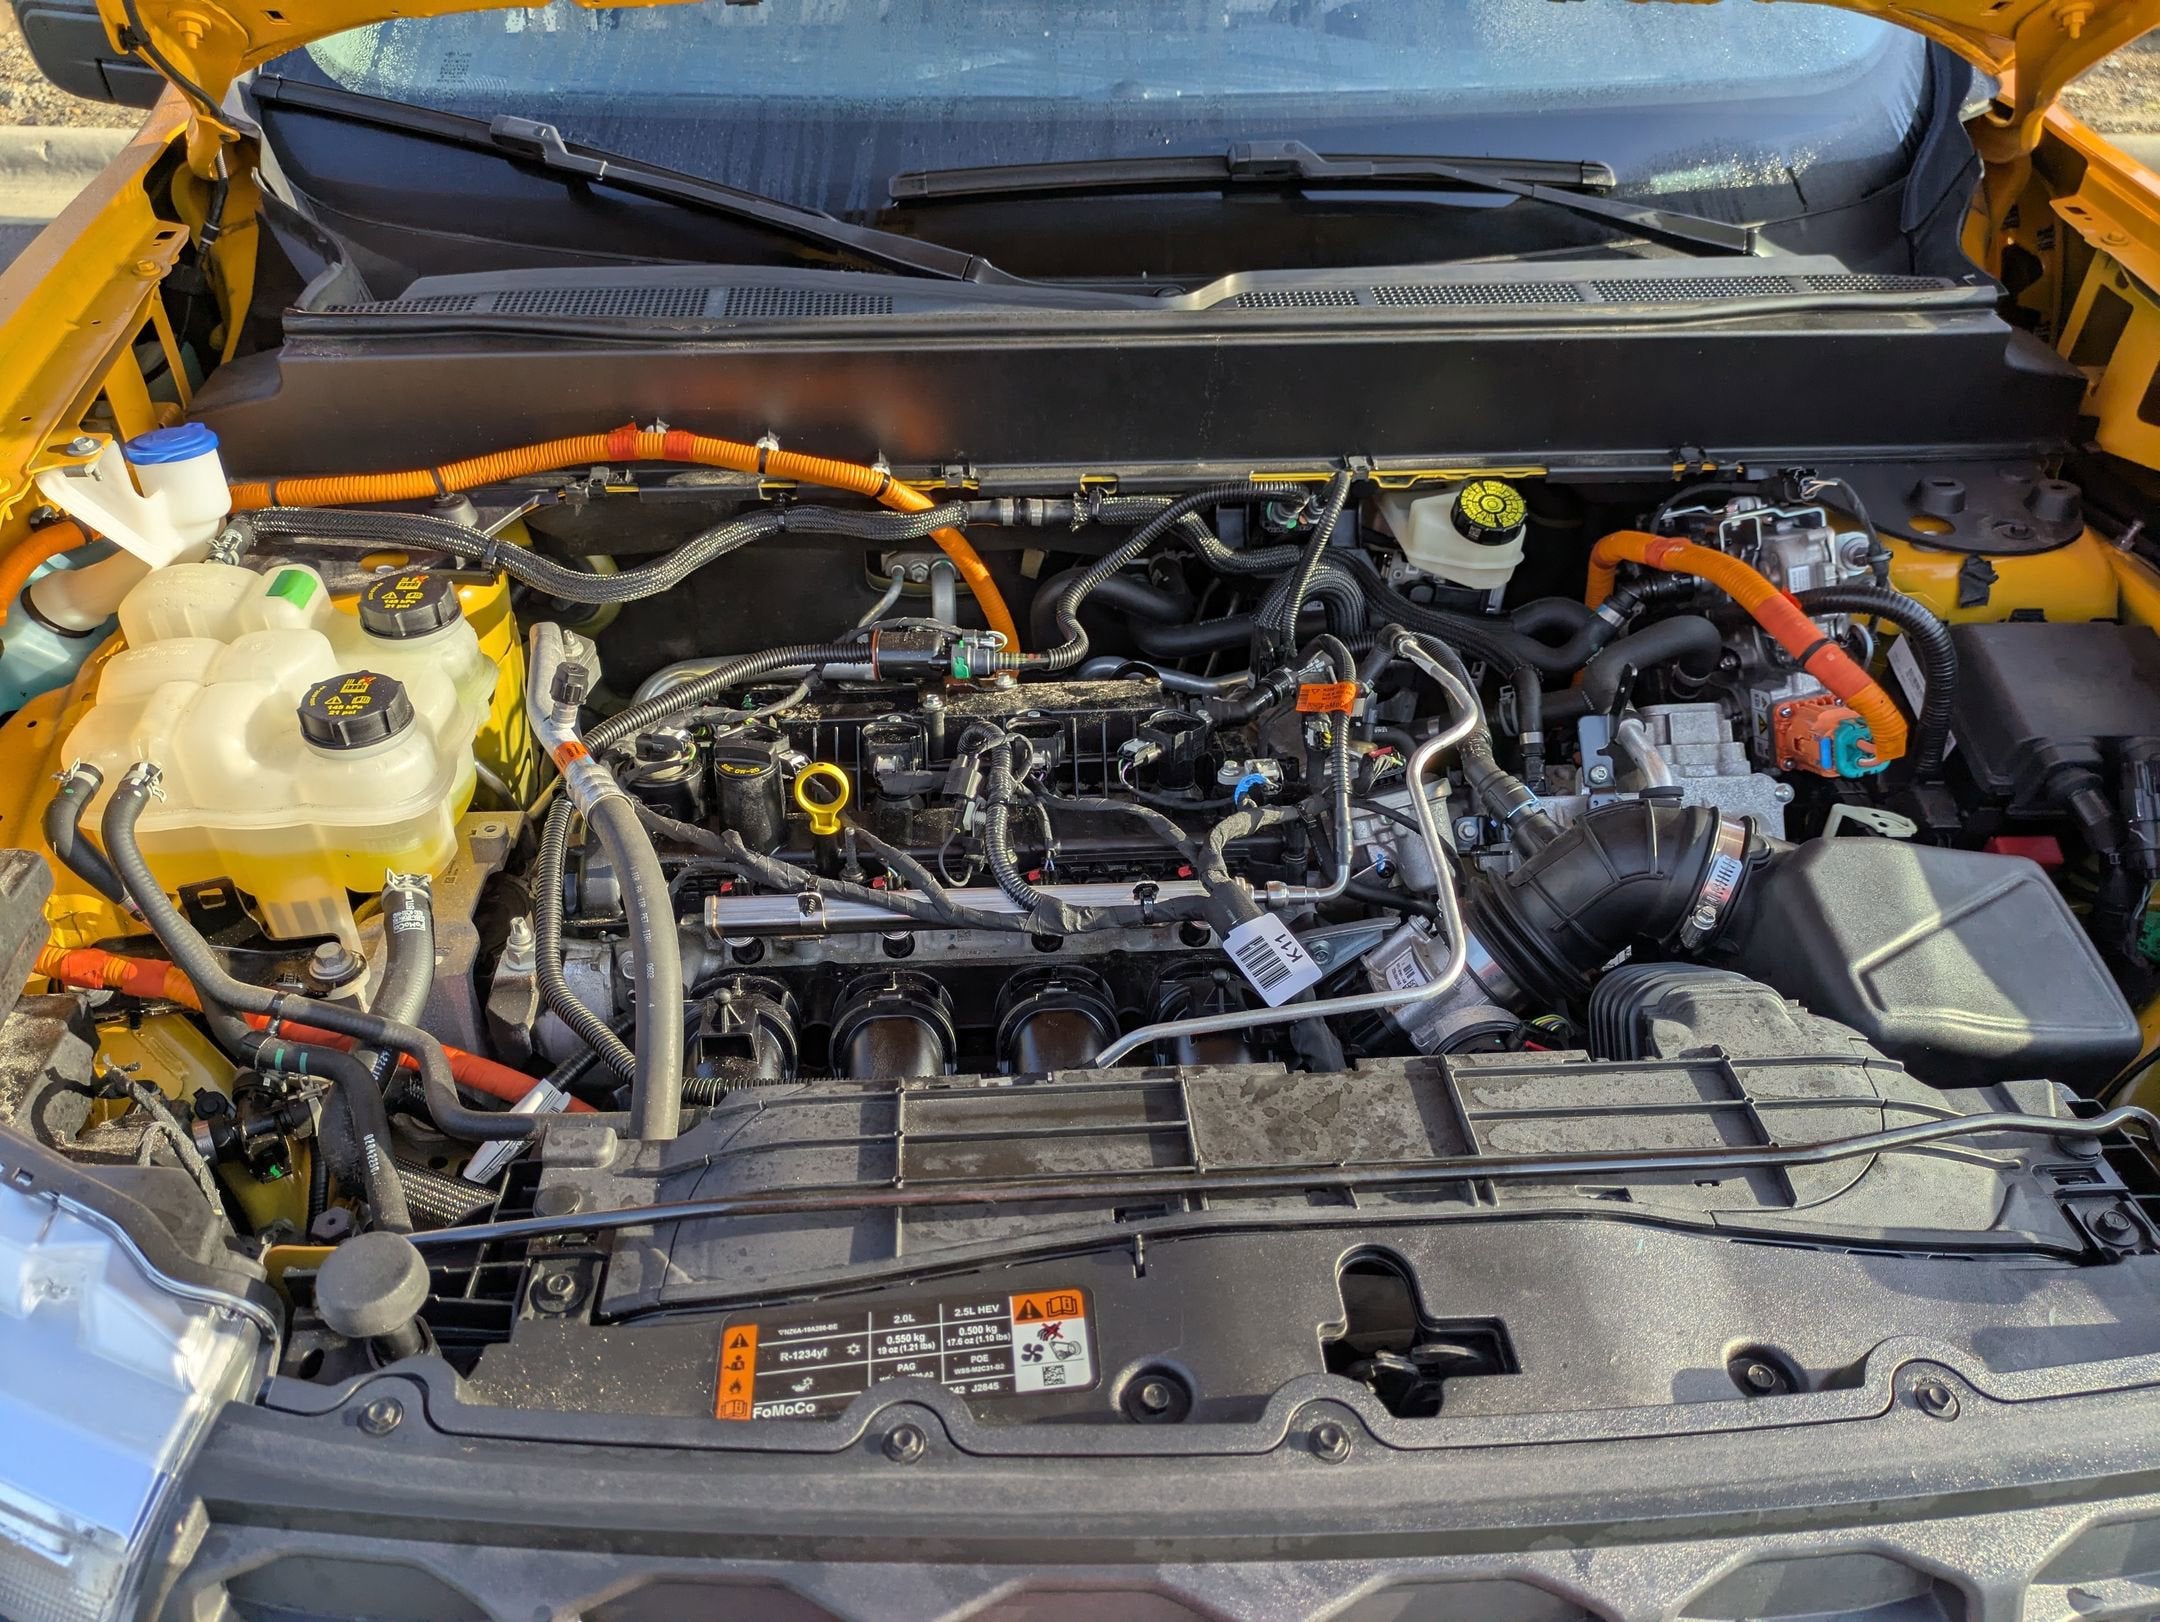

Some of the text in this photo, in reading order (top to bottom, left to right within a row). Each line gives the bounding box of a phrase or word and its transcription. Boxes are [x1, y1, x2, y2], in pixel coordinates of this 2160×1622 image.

[1274, 933, 1303, 963] K11
[954, 1304, 1000, 1317] 2.5L HEV
[893, 1314, 916, 1324] 2.0L
[958, 1324, 998, 1336] 0.500 kg
[886, 1333, 926, 1345] 0.550 kg
[946, 1338, 964, 1347] 17.6
[975, 1334, 995, 1345] (1.10
[995, 1332, 1011, 1342] lbs)
[877, 1346, 887, 1355] 19
[899, 1343, 919, 1354] (1.21
[919, 1341, 936, 1351] lbs)
[780, 1347, 829, 1362] R-1234yf
[970, 1354, 989, 1363] POE
[897, 1362, 916, 1372] PAG
[971, 1382, 1000, 1393] J2845
[753, 1402, 816, 1419] FoMoCo
